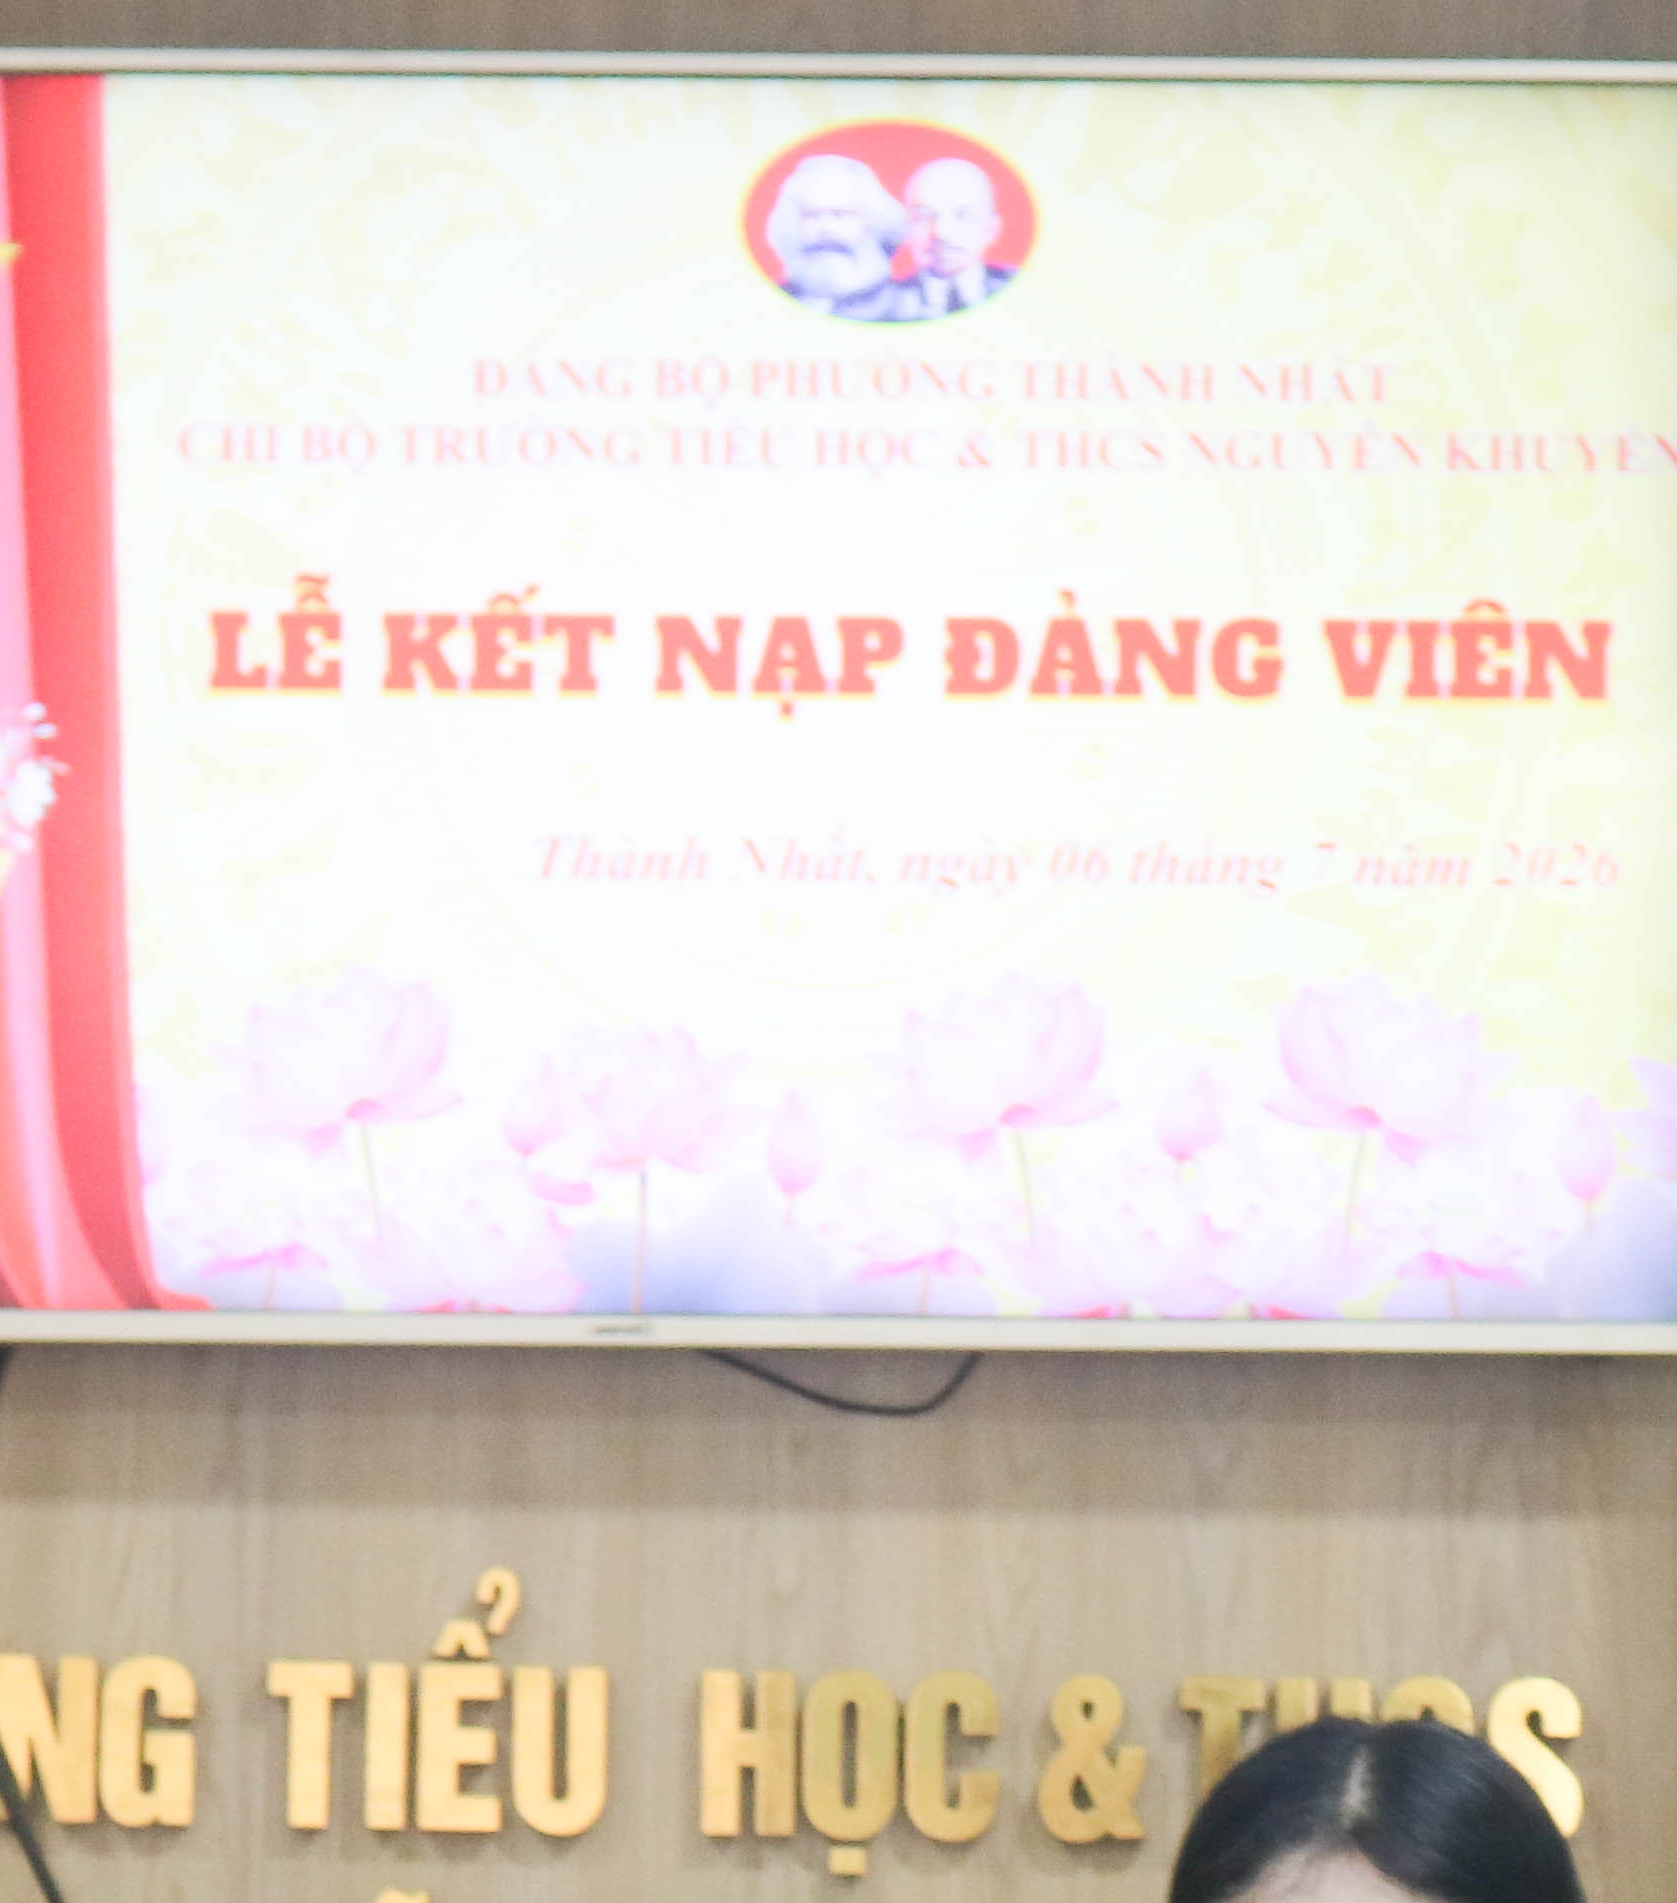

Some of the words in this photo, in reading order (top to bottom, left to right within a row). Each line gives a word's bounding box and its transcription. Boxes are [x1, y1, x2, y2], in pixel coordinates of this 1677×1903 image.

[175, 421, 281, 466] CHI
[813, 426, 935, 479] HỌC
[953, 430, 996, 471] &
[1015, 428, 1168, 471] THCS
[209, 573, 343, 692] LỄ
[382, 585, 616, 693] KẾT
[654, 614, 905, 718] NẠP
[944, 589, 1285, 700] ĐẢNG
[1322, 599, 1613, 701] VIÊN
[1491, 840, 1623, 889] 2026
[267, 1567, 608, 1838] TIỂU
[699, 1669, 1000, 1877] HỌC
[1037, 1674, 1147, 1842] &
[1179, 1676, 1584, 1838] TS
